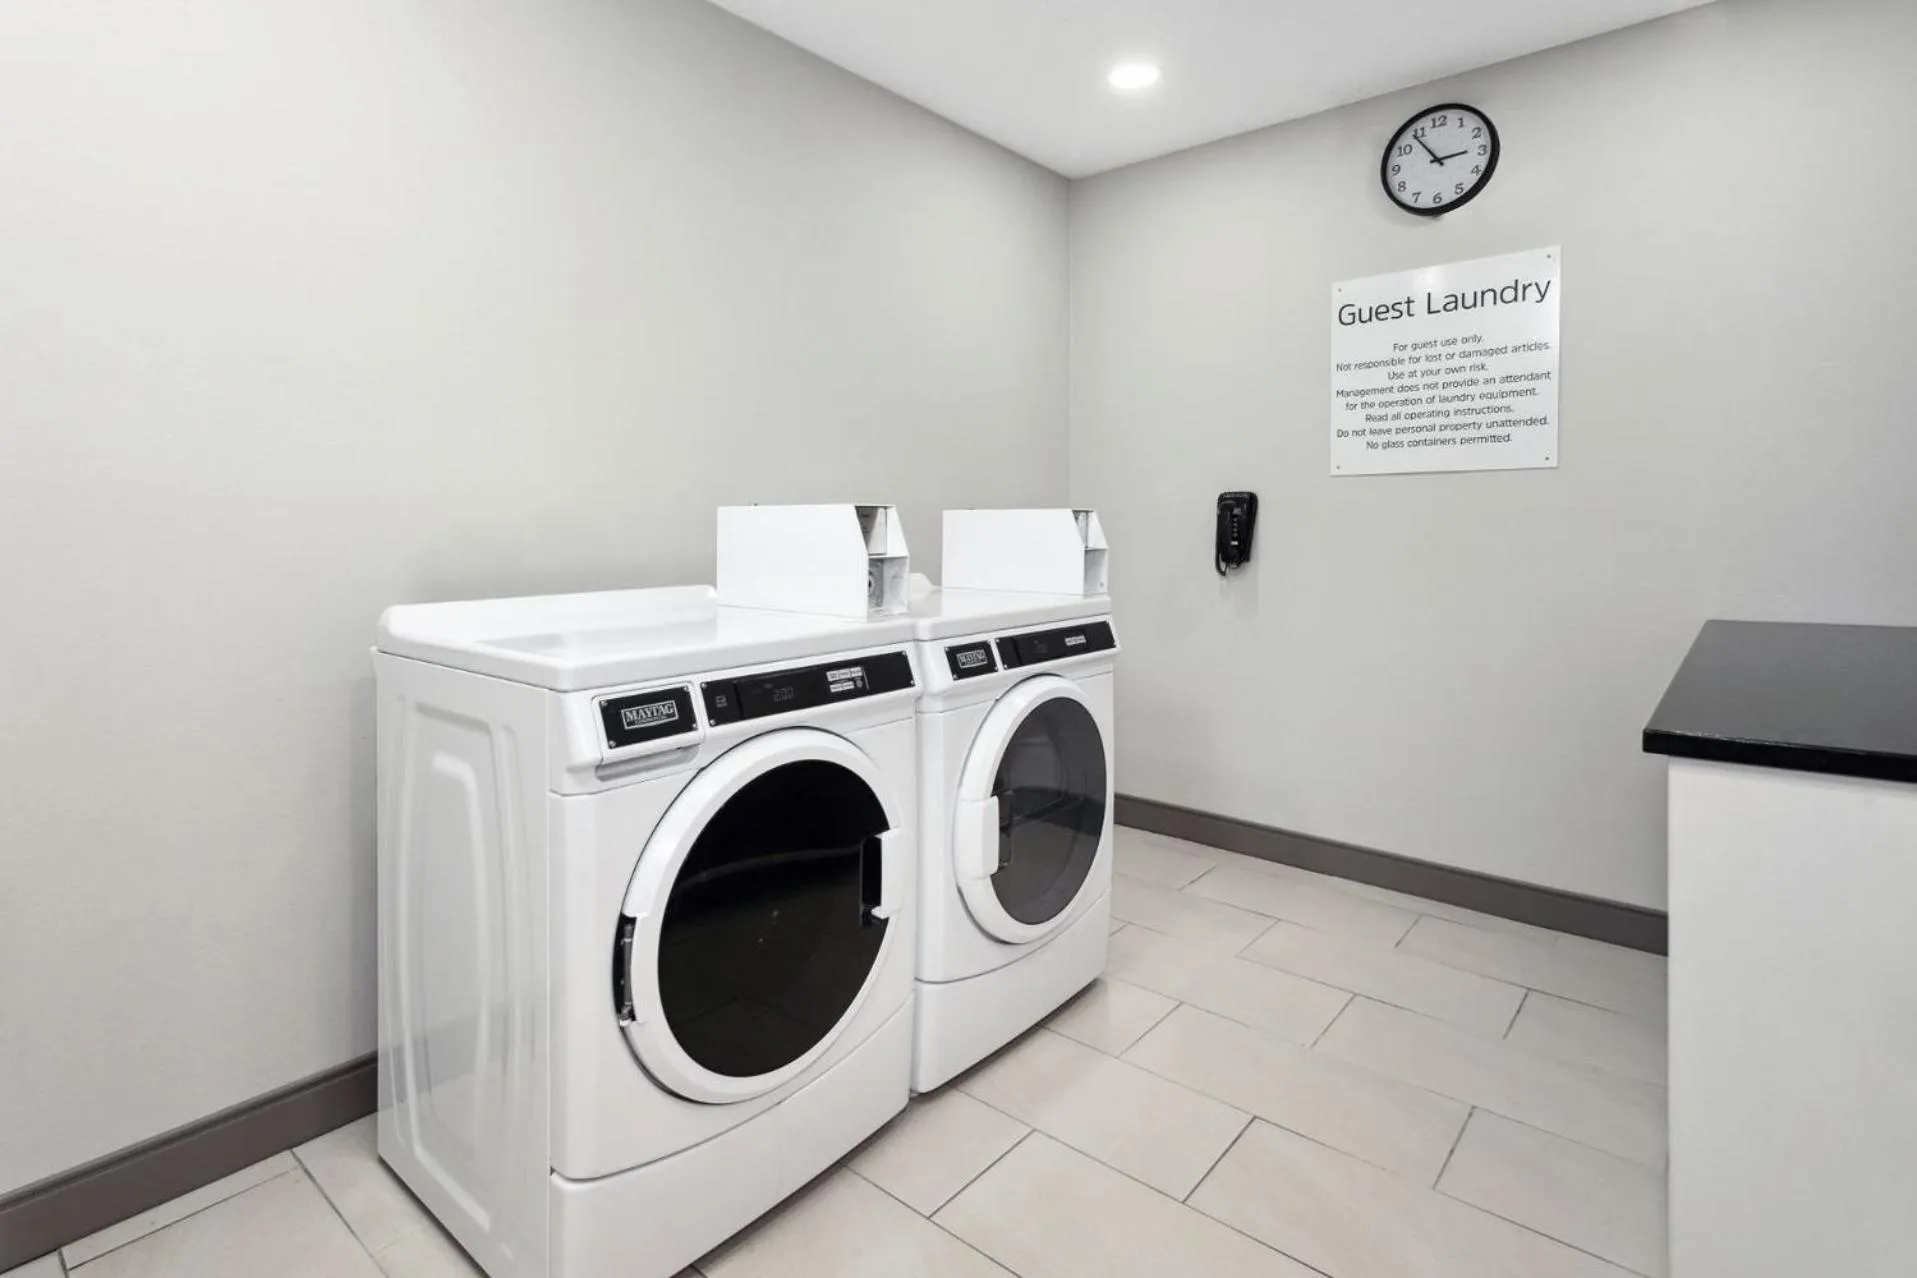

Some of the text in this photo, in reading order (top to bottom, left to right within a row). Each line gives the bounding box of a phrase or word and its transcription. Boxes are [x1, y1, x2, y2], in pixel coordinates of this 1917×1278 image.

[1430, 115, 1447, 128] 12
[1458, 117, 1464, 128] 1
[1413, 127, 1426, 138] 11
[1472, 127, 1482, 139] 2
[1397, 144, 1412, 156] 10
[1478, 145, 1487, 156] 3
[1392, 165, 1400, 176] 9
[1471, 165, 1481, 176] 4
[1398, 181, 1406, 192] 8
[1454, 182, 1464, 195] 5
[1412, 192, 1421, 203] 7
[1433, 193, 1442, 204] 6
[1338, 279, 1551, 326] Guest Laundry
[1393, 334, 1484, 352] For guest use only.
[1336, 341, 1551, 372] Not responsible for lost or damaged articles.
[1388, 363, 1488, 380] Use at your own risk.
[1336, 372, 1551, 397] Management does not provide an attendant
[1345, 387, 1538, 410] for the operation of laundry equipment.
[1366, 405, 1514, 421] Read all operating instructions.
[1337, 417, 1549, 437] Do not leave personal property unattended.
[1367, 434, 1512, 449] No glass containers permitted.
[625, 703, 674, 722] MAYTAG
